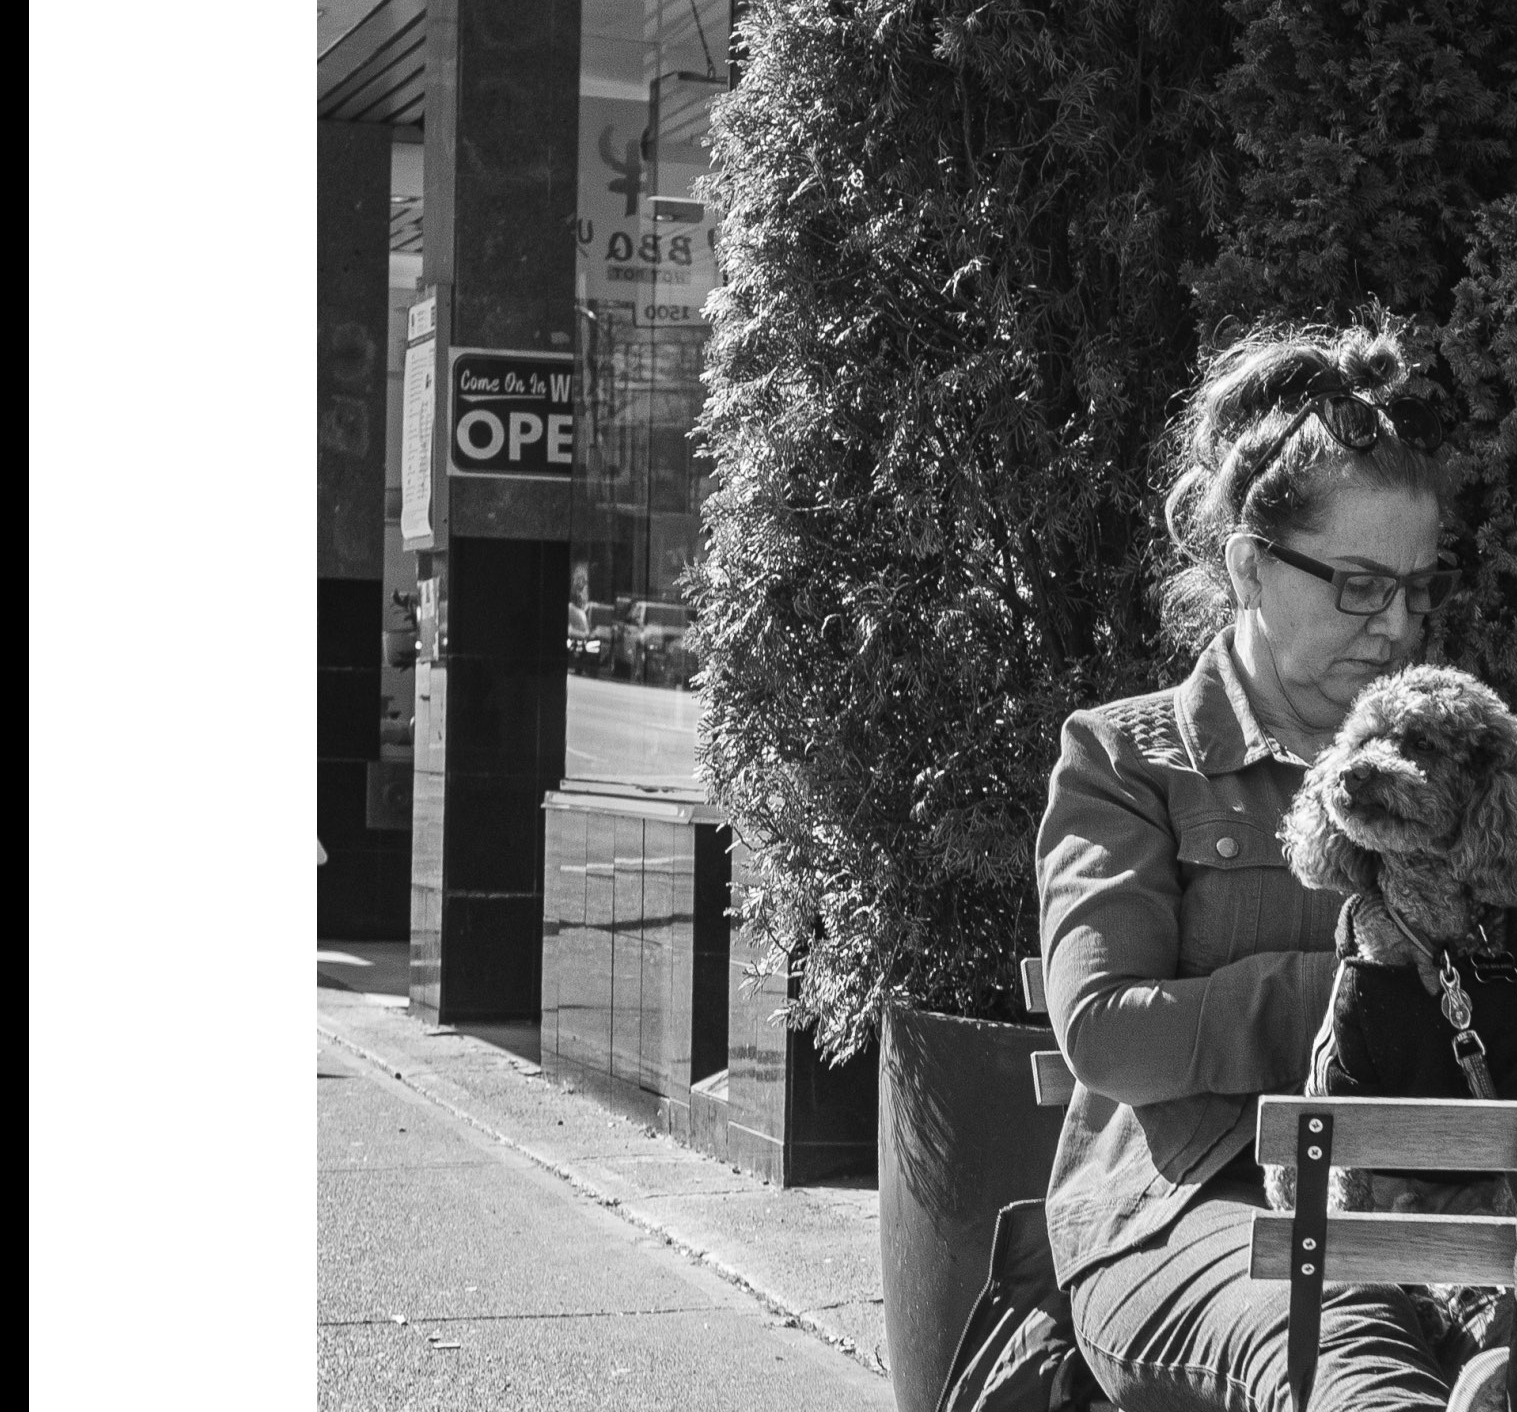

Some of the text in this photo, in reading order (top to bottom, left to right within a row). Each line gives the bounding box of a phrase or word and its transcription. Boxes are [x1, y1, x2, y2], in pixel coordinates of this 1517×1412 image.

[460, 369, 500, 392] Come
[504, 371, 526, 393] On
[529, 372, 547, 394] In
